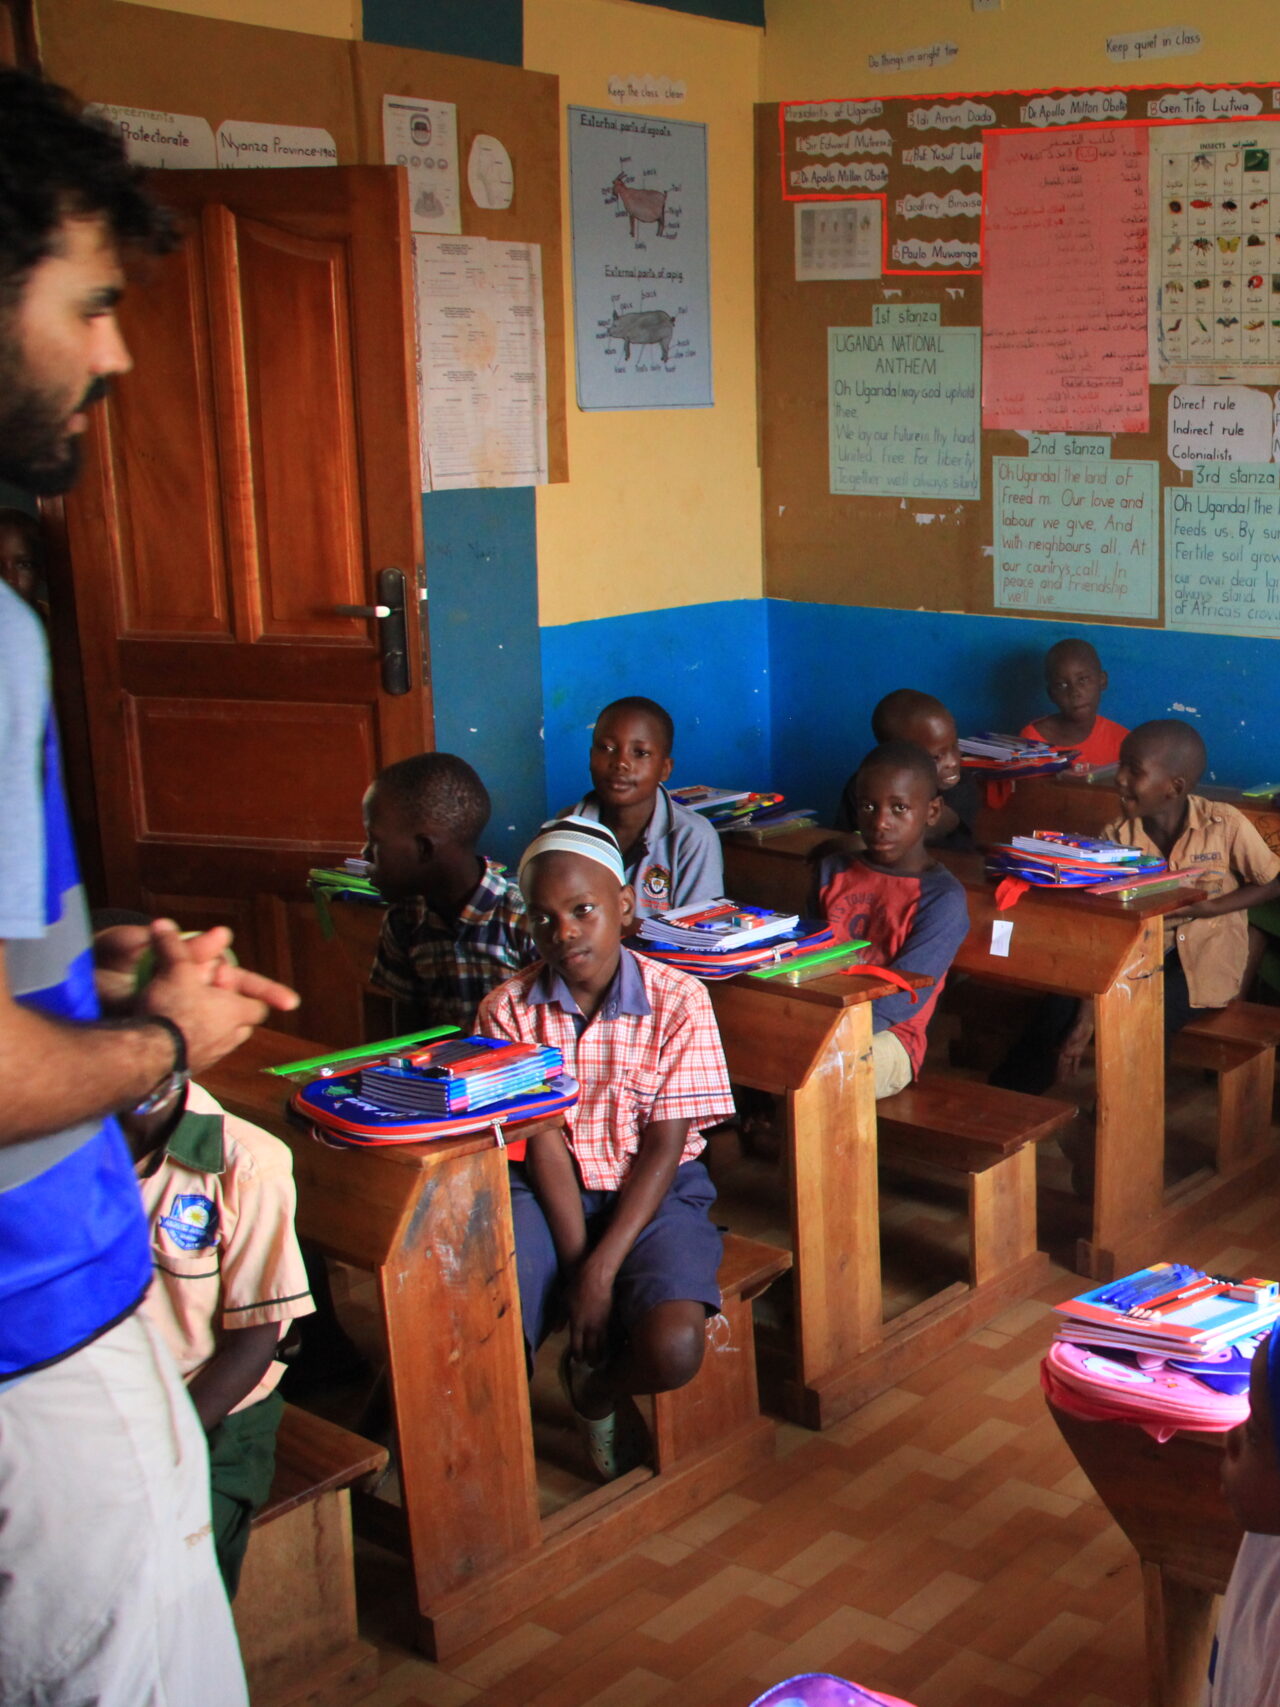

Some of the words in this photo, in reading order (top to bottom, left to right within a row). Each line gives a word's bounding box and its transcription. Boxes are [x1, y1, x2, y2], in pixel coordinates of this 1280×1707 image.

[1184, 97, 1205, 112] Tito
[967, 109, 992, 122] Dada
[119, 121, 190, 147] Protectorate
[221, 132, 268, 158] Nyanza
[1200, 142, 1226, 150] INSECTS
[874, 307, 890, 325] 1st
[898, 309, 937, 325] stanza
[836, 335, 883, 353] UGANDA
[891, 335, 944, 353] NATIONAL
[875, 358, 937, 375] ANTHEM
[834, 379, 852, 396] Oh
[855, 379, 897, 404] Uganda
[1173, 395, 1205, 410] Direct
[1213, 397, 1236, 411] rule
[1173, 420, 1214, 435] Indirect
[1222, 422, 1244, 436] rule
[1031, 437, 1056, 455] 2nd
[1064, 440, 1105, 455] stanza
[1172, 444, 1232, 461] Colonialists
[1196, 465, 1220, 484] 3rd
[1229, 468, 1275, 484] stanza
[1174, 494, 1192, 513] Oh
[1254, 497, 1273, 515] the
[1002, 510, 1036, 528] labour
[1043, 519, 1059, 529] we
[1104, 514, 1133, 532] And
[1028, 536, 1091, 558] neighbours
[1222, 544, 1244, 562] soil
